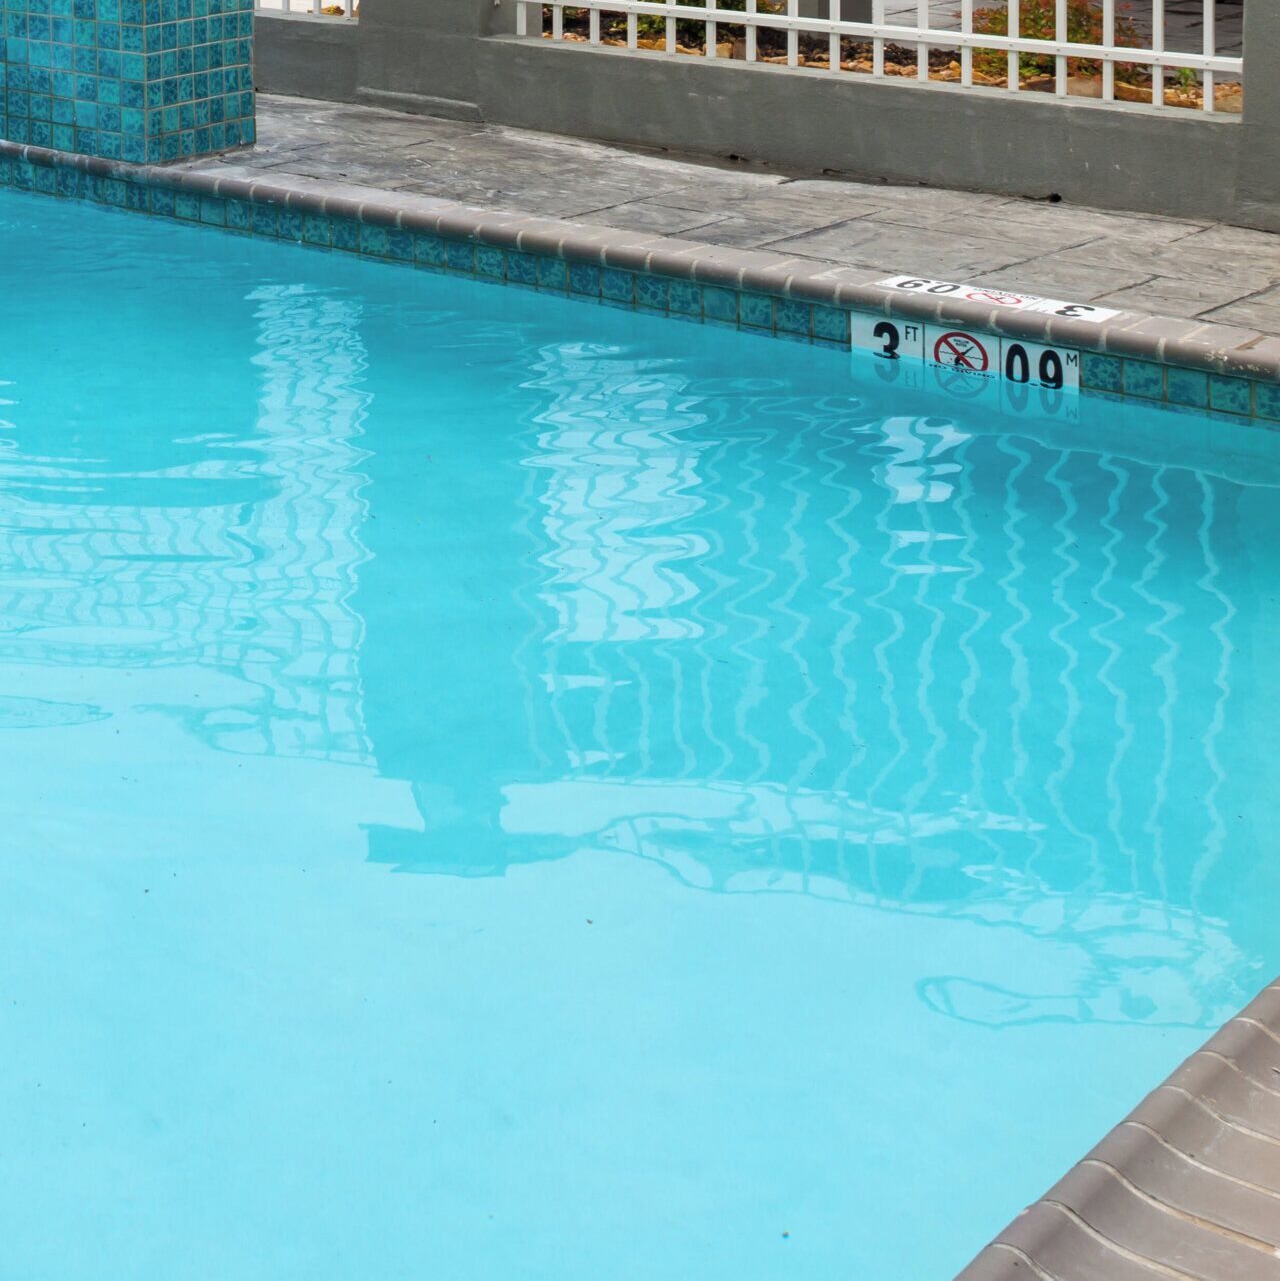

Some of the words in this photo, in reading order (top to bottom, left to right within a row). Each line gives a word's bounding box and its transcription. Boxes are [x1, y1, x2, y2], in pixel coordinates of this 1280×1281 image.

[873, 322, 900, 359] 3
[905, 325, 919, 341] FT
[1066, 352, 1078, 367] M
